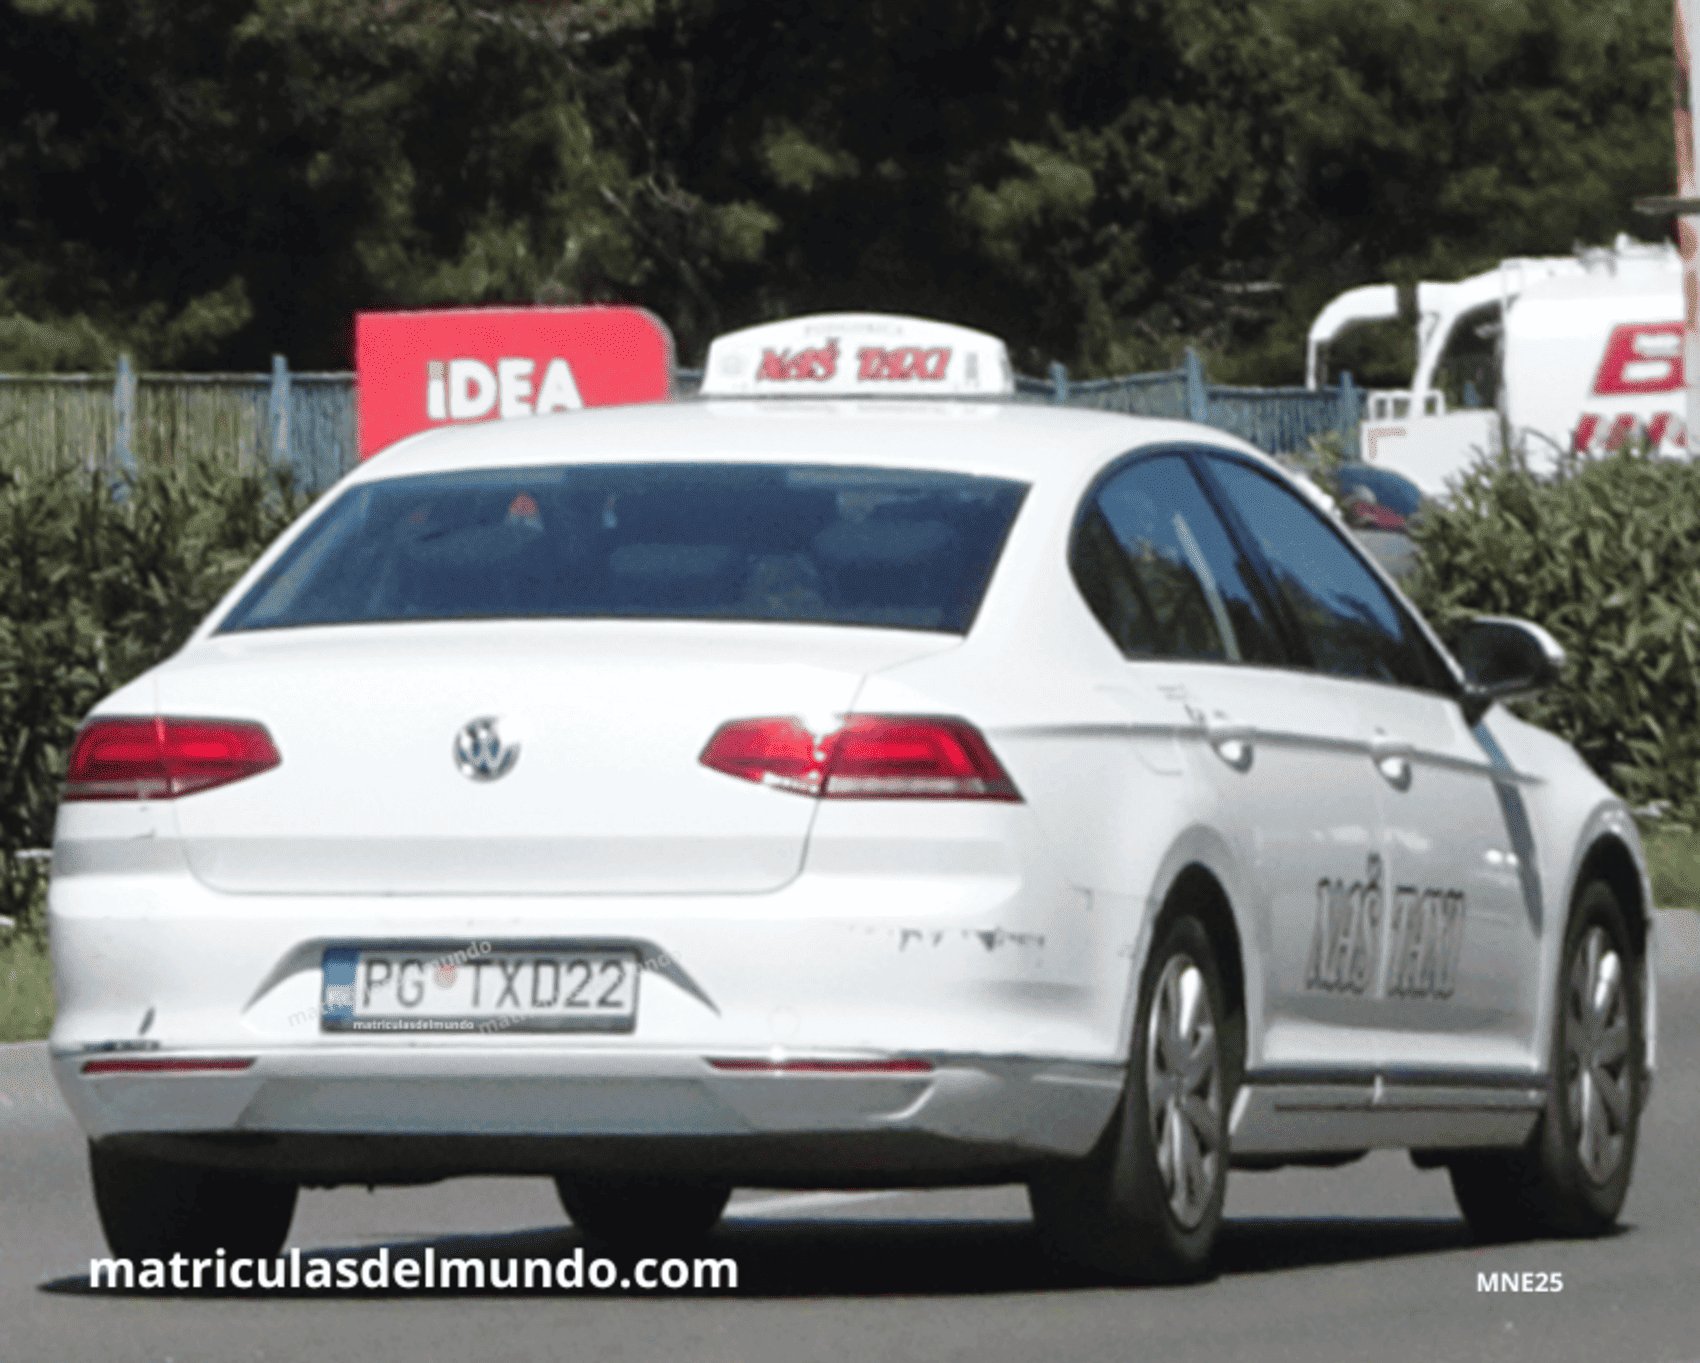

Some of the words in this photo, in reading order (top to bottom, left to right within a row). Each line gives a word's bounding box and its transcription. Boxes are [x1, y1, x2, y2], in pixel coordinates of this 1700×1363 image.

[856, 345, 953, 383] TAXI
[362, 958, 425, 1009] PG
[470, 958, 625, 1009] TXD22
